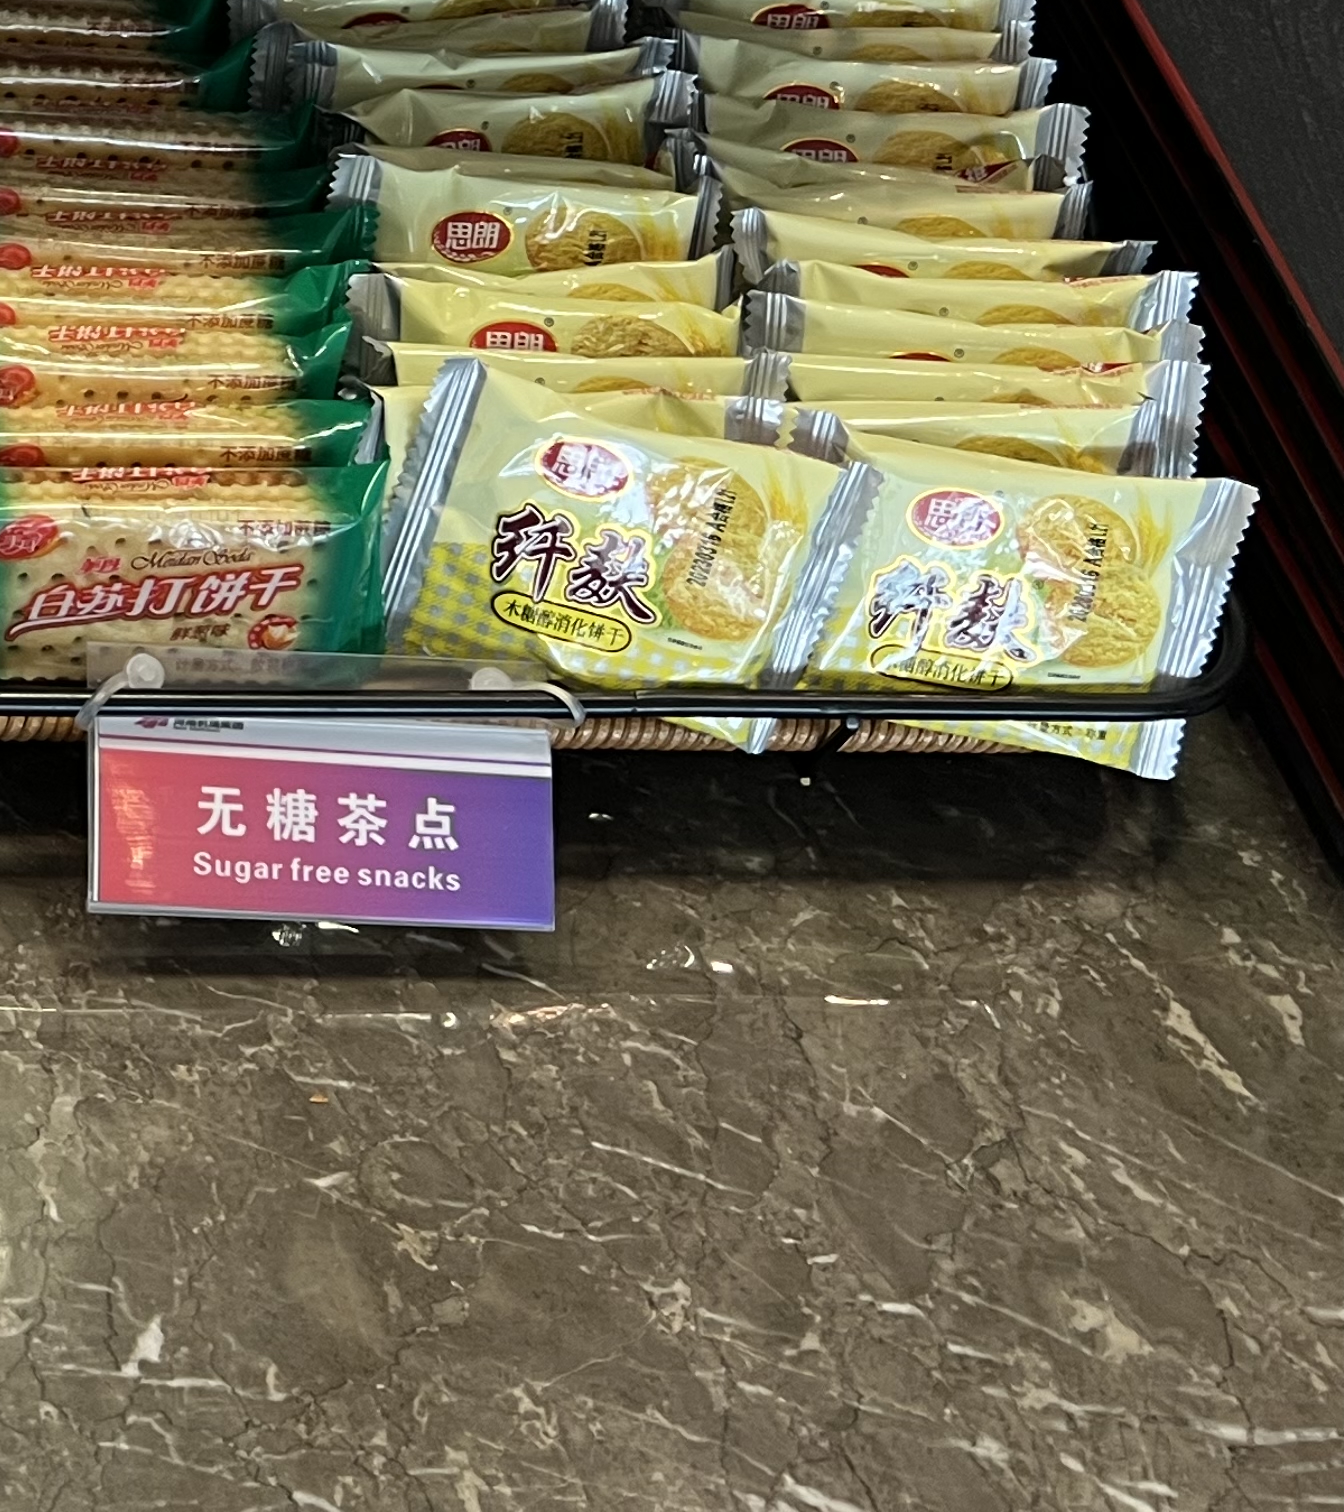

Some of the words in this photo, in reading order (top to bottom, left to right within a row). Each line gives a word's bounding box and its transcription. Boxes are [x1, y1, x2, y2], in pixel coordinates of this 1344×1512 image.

[443, 221, 500, 250] 思朗
[20, 563, 305, 628] 白苏打饼干
[502, 598, 627, 648] 木糖醇消化饼干
[196, 785, 460, 851] 无糖茶点
[192, 851, 284, 884] Sugar
[289, 860, 351, 886] free
[356, 865, 462, 892] snacks
